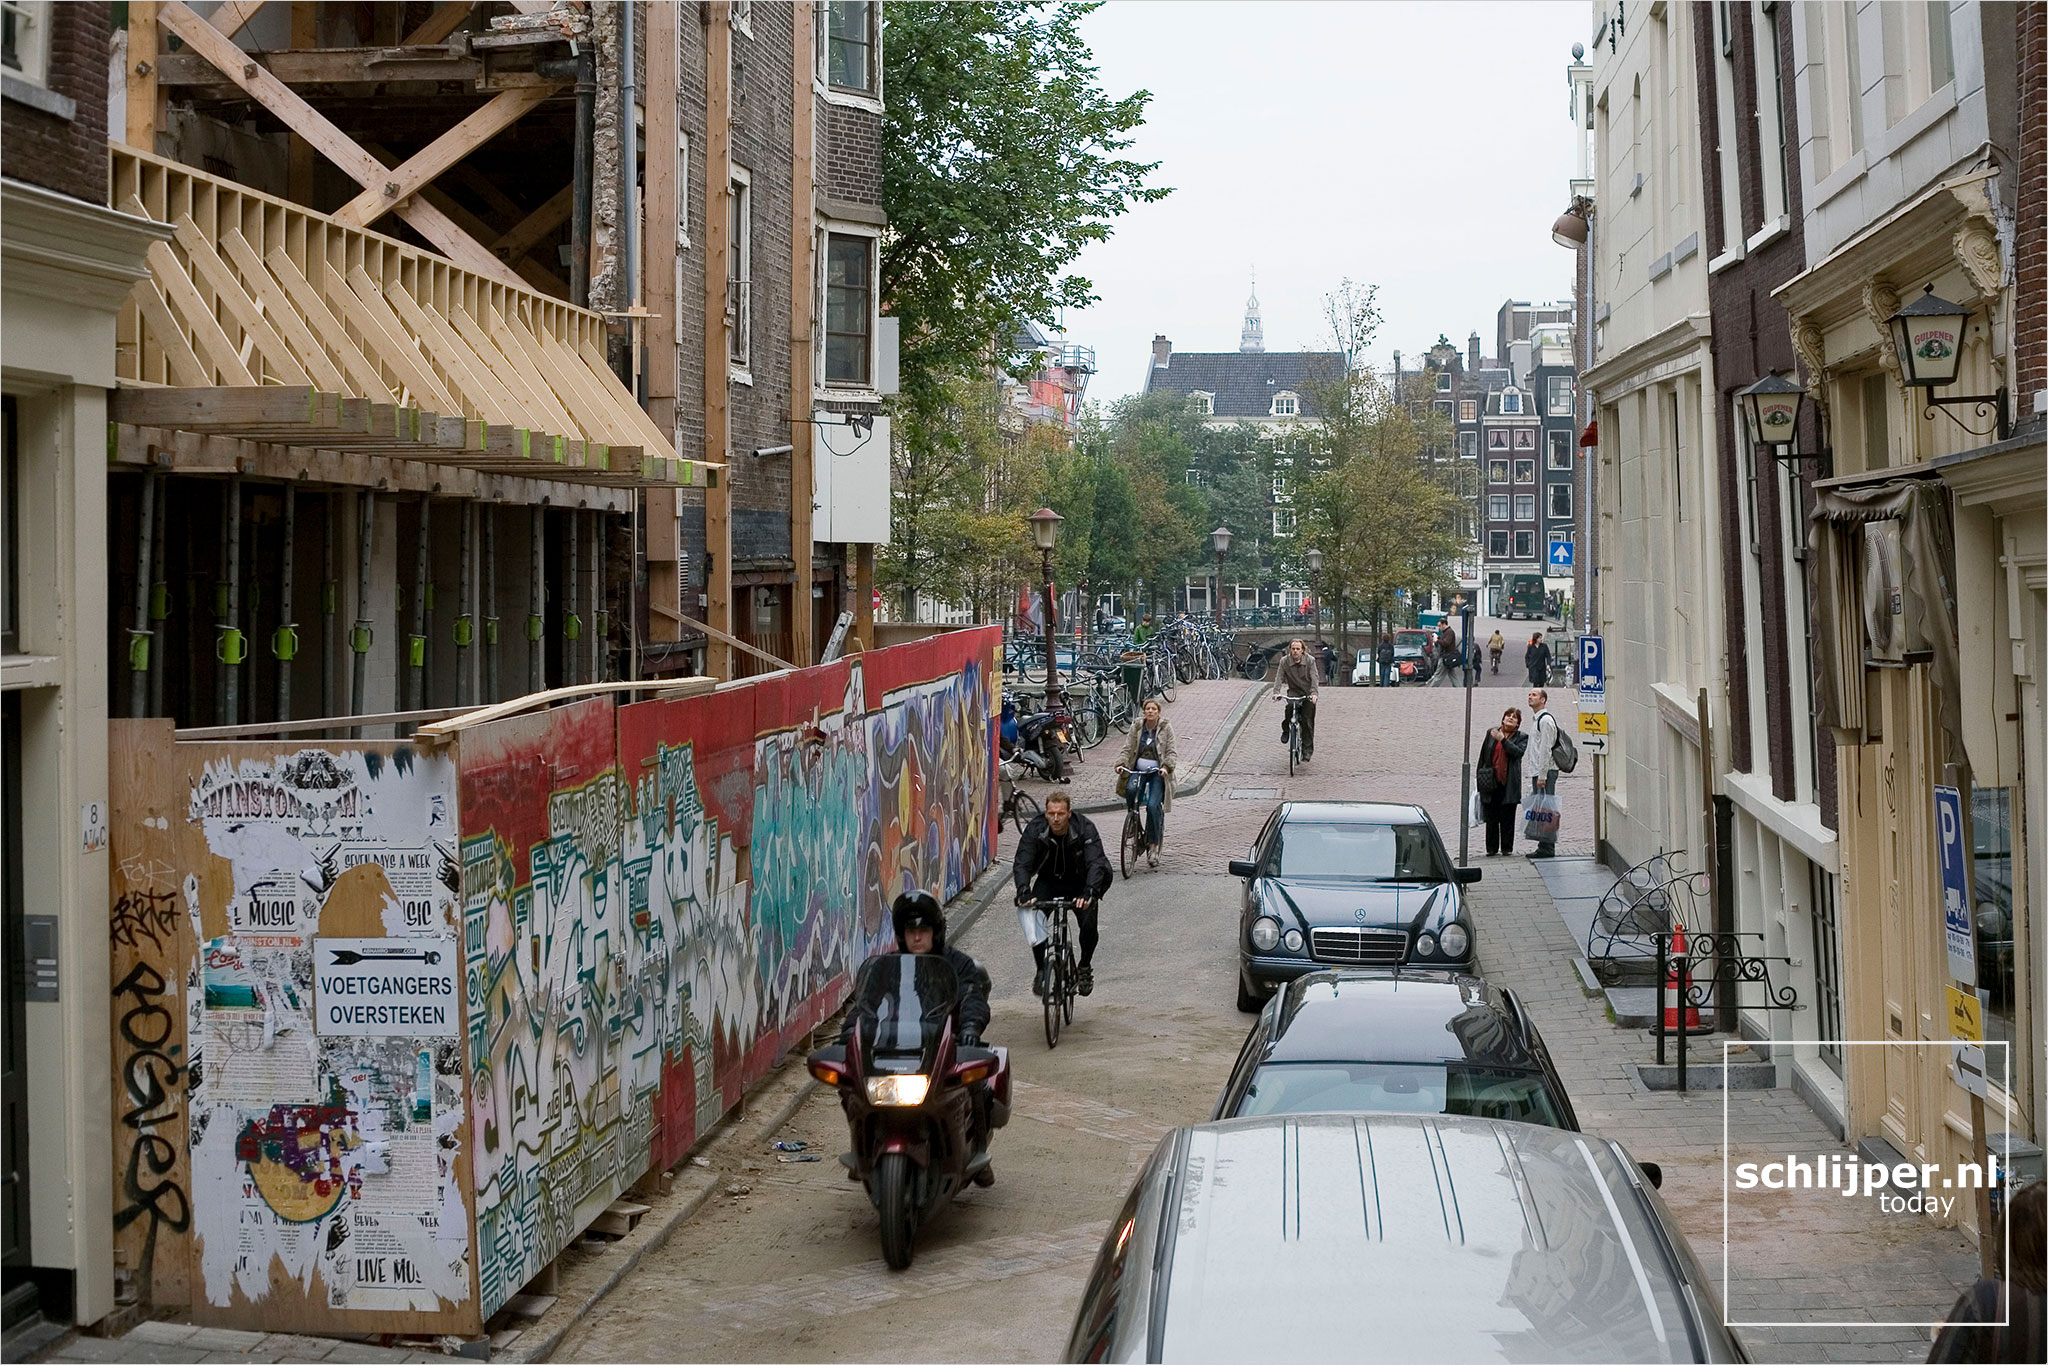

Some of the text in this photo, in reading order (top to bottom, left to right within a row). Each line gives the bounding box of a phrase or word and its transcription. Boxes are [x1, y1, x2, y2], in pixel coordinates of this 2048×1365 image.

[1914, 331, 1954, 345] GULPENER
[1763, 405, 1793, 416] GULPENER
[1585, 640, 1598, 669] P
[202, 780, 301, 819] WINSTON
[90, 804, 98, 824] 8
[1525, 810, 1553, 823] GOODS
[1941, 801, 1956, 869] P
[399, 853, 405, 868] A
[408, 853, 431, 868] WEEK
[249, 900, 295, 926] MUSIC
[321, 976, 452, 995] VOETGANGERS
[330, 1005, 446, 1024] OVERSTEKEN
[357, 1258, 387, 1283] LIVE
